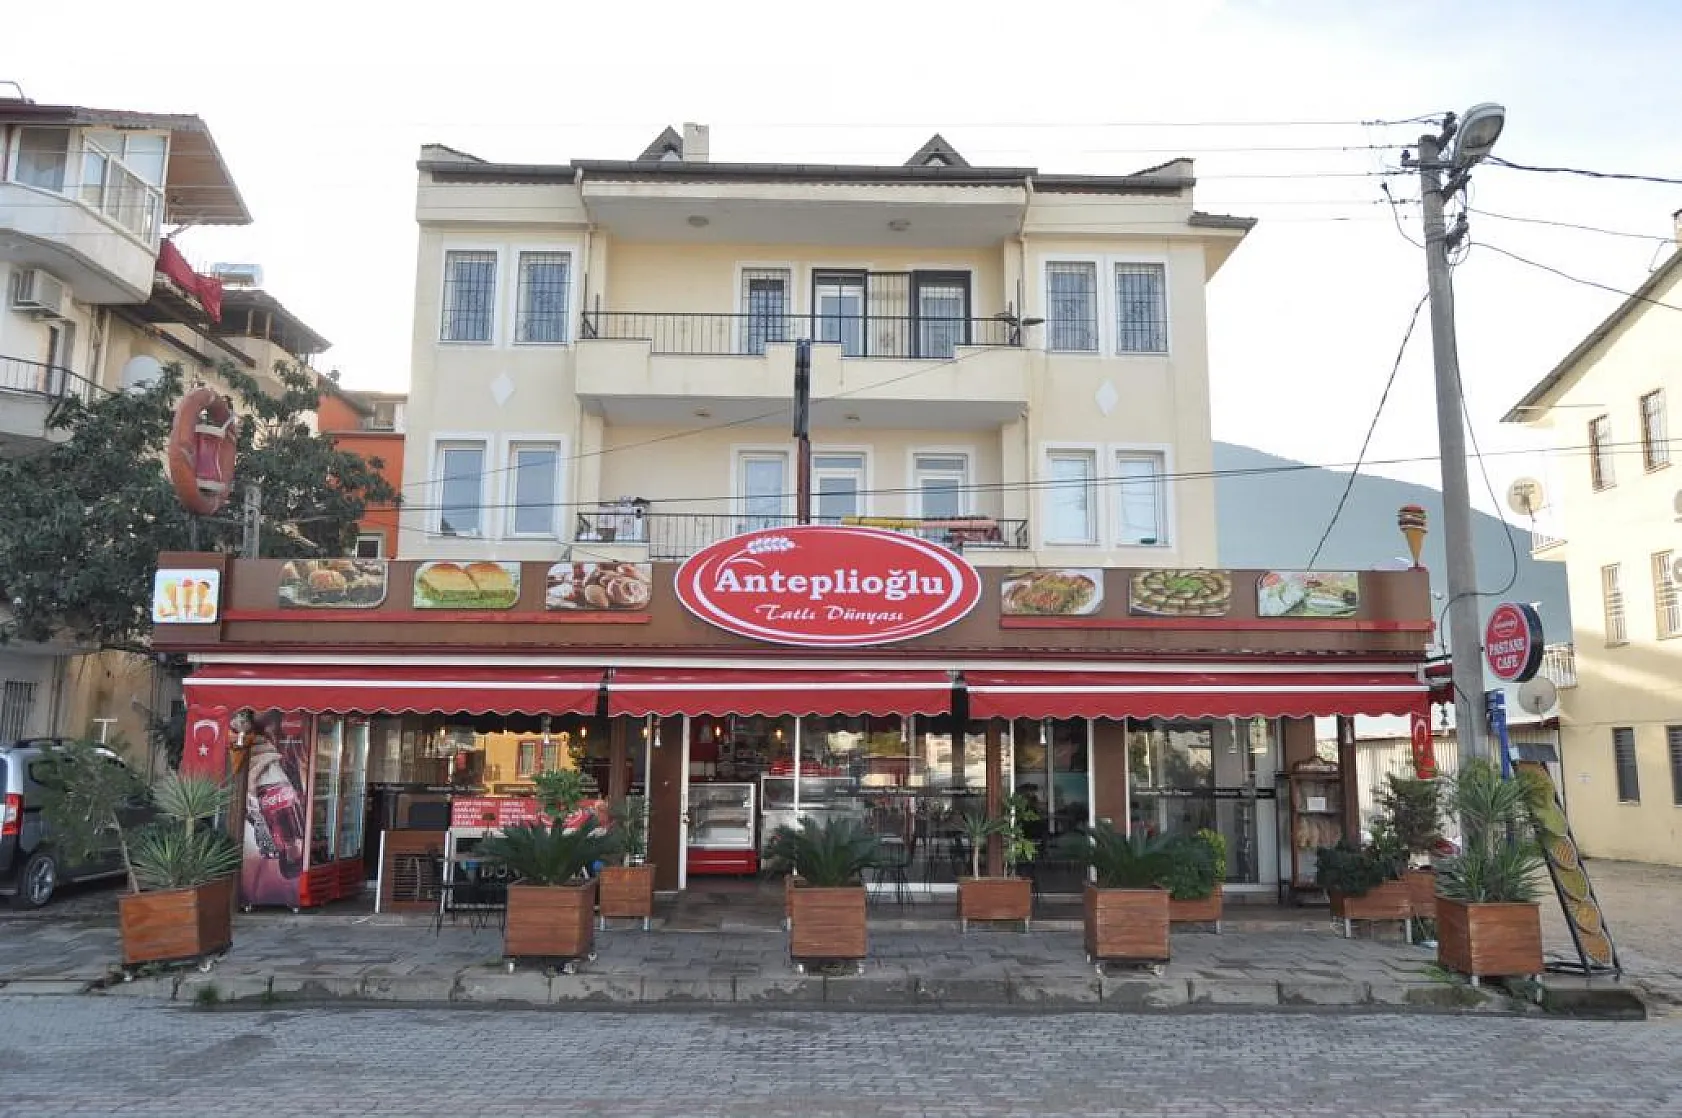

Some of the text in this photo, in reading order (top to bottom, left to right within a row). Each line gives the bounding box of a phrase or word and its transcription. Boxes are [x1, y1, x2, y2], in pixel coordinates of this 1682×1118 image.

[714, 568, 945, 600] Anteplioğlu
[755, 604, 904, 624] Tatlı Dünyası
[1497, 654, 1519, 669] CAFE
